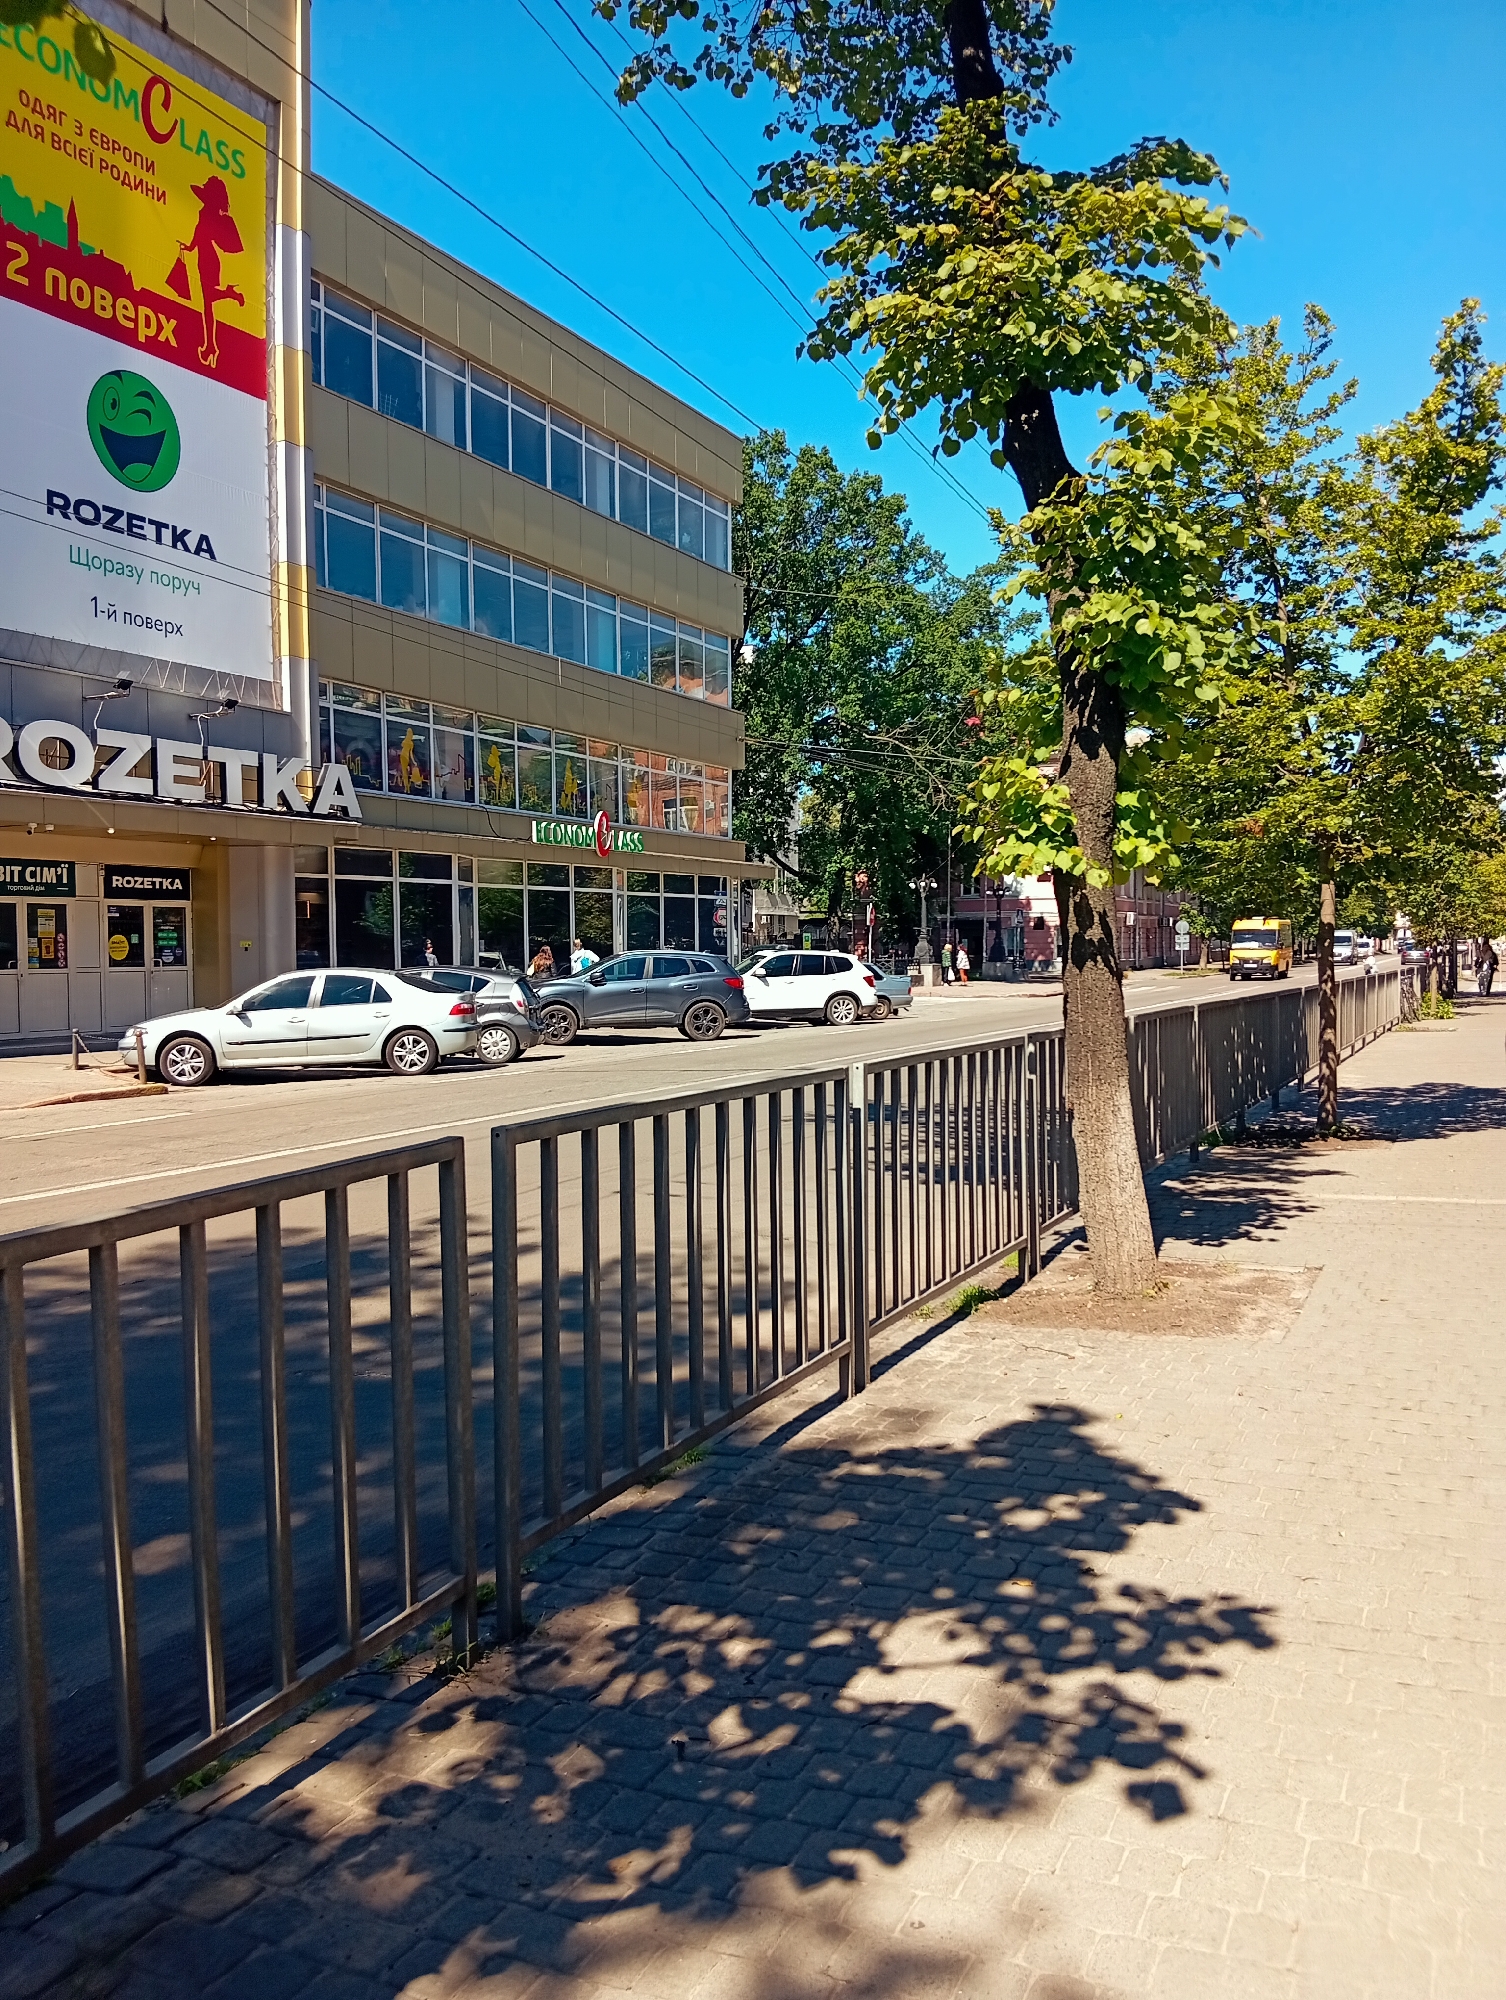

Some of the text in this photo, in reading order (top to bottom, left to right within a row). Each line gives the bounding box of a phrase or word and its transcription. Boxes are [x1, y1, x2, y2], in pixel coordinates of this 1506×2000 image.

[6, 110, 167, 205] ДЛЯ ВСІЄЇ РОДИНИ
[19, 89, 67, 126] ОДЯГ
[90, 128, 156, 176] ЄВРОПИ
[6, 241, 178, 348] 2 поверх
[46, 489, 217, 560] ROZETKA
[69, 544, 201, 595] Щоразу поруч
[90, 596, 183, 637] 1-й поверх
[25, 864, 69, 884] СІМ'Ї
[112, 876, 183, 890] ROZETKA
